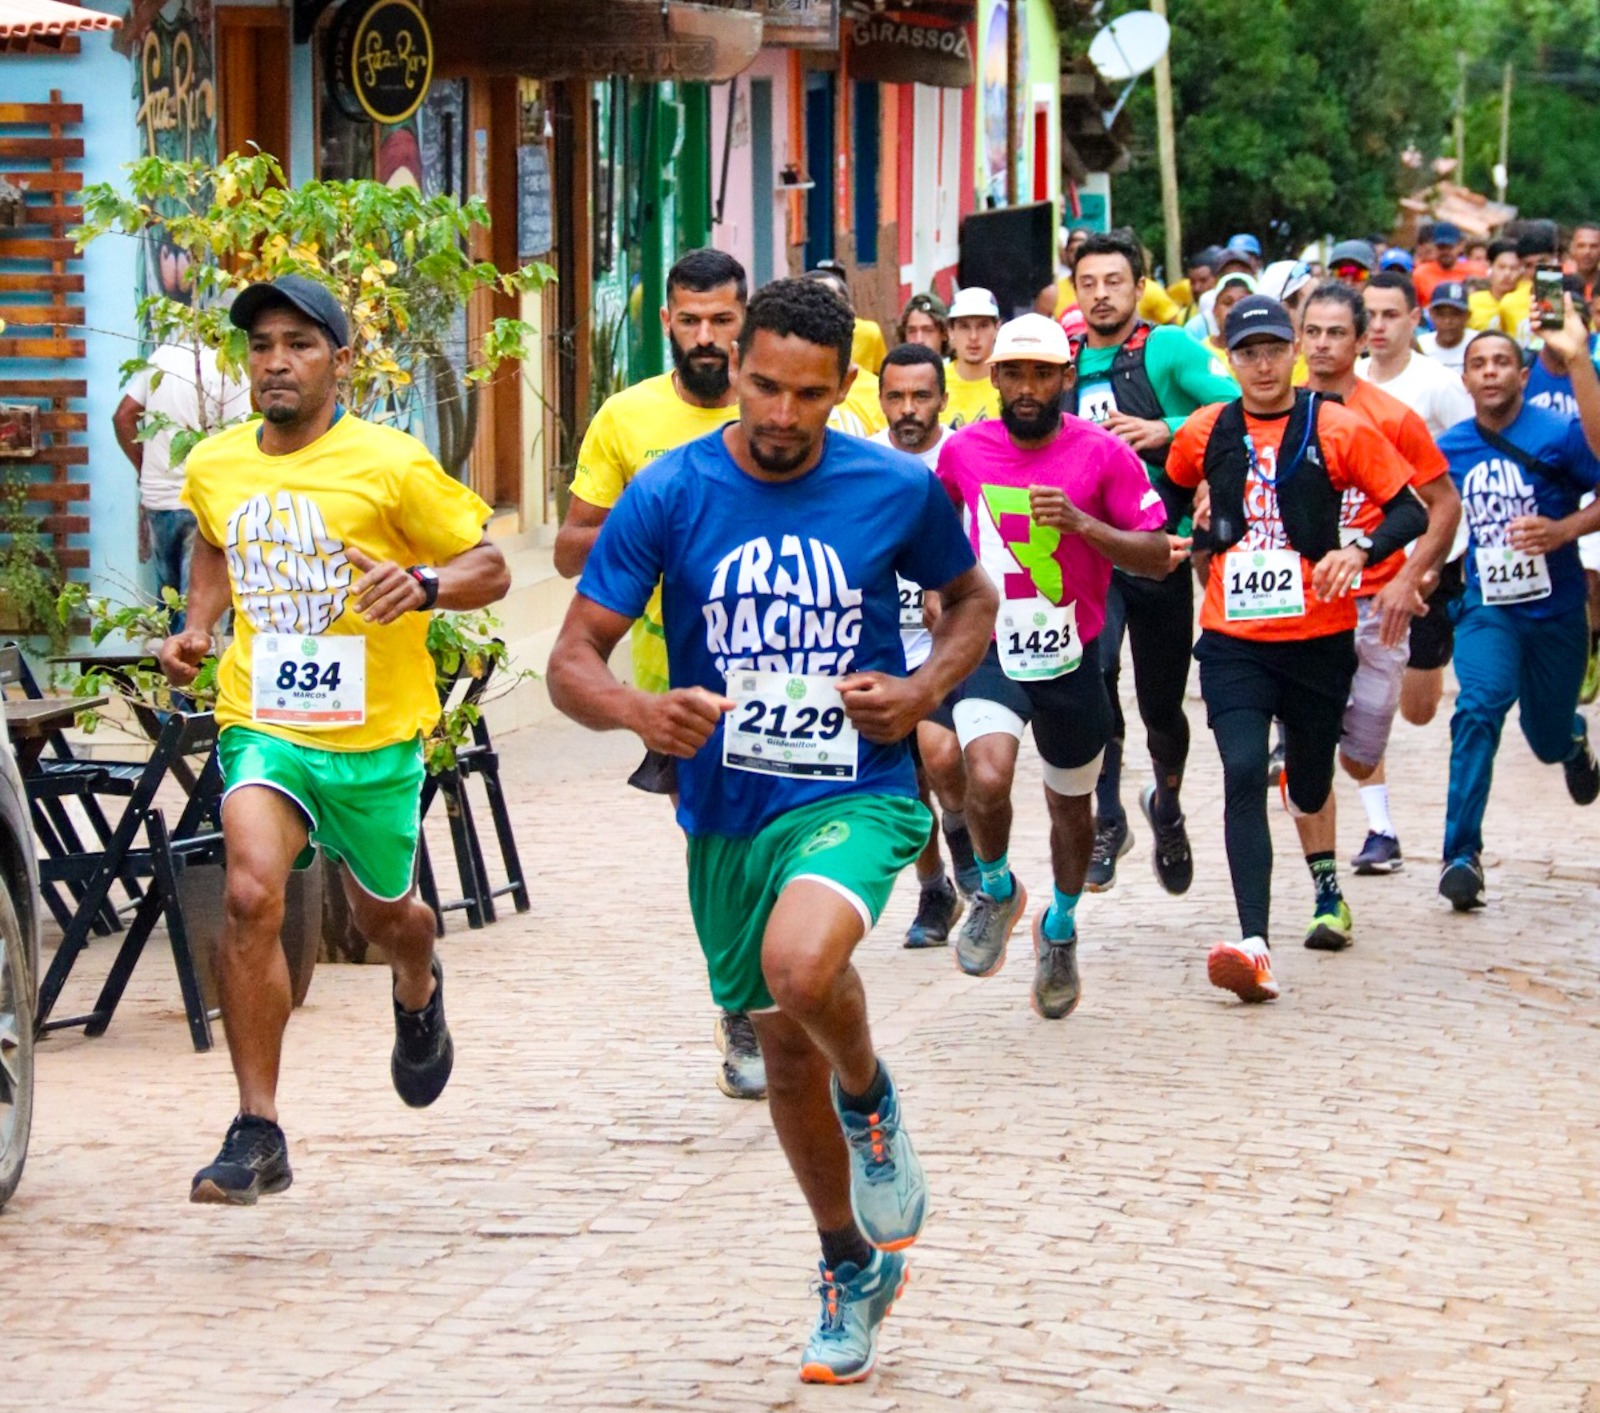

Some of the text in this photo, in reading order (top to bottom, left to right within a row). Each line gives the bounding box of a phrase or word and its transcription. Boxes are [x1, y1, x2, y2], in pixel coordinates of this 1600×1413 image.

[852, 21, 967, 57] GIRASSOL
[1462, 457, 1535, 498] TRAIL
[227, 490, 344, 556] TRAIL
[226, 544, 352, 596] RACING
[708, 534, 863, 608] TRAIL
[1230, 569, 1293, 595] 1402
[1487, 559, 1539, 583] 2141
[702, 598, 863, 655] RACING
[1008, 624, 1071, 655] 1423
[276, 660, 342, 692] 834
[293, 691, 327, 699] MARCOS
[738, 700, 845, 740] 2129
[766, 737, 817, 749] Gildenilton
